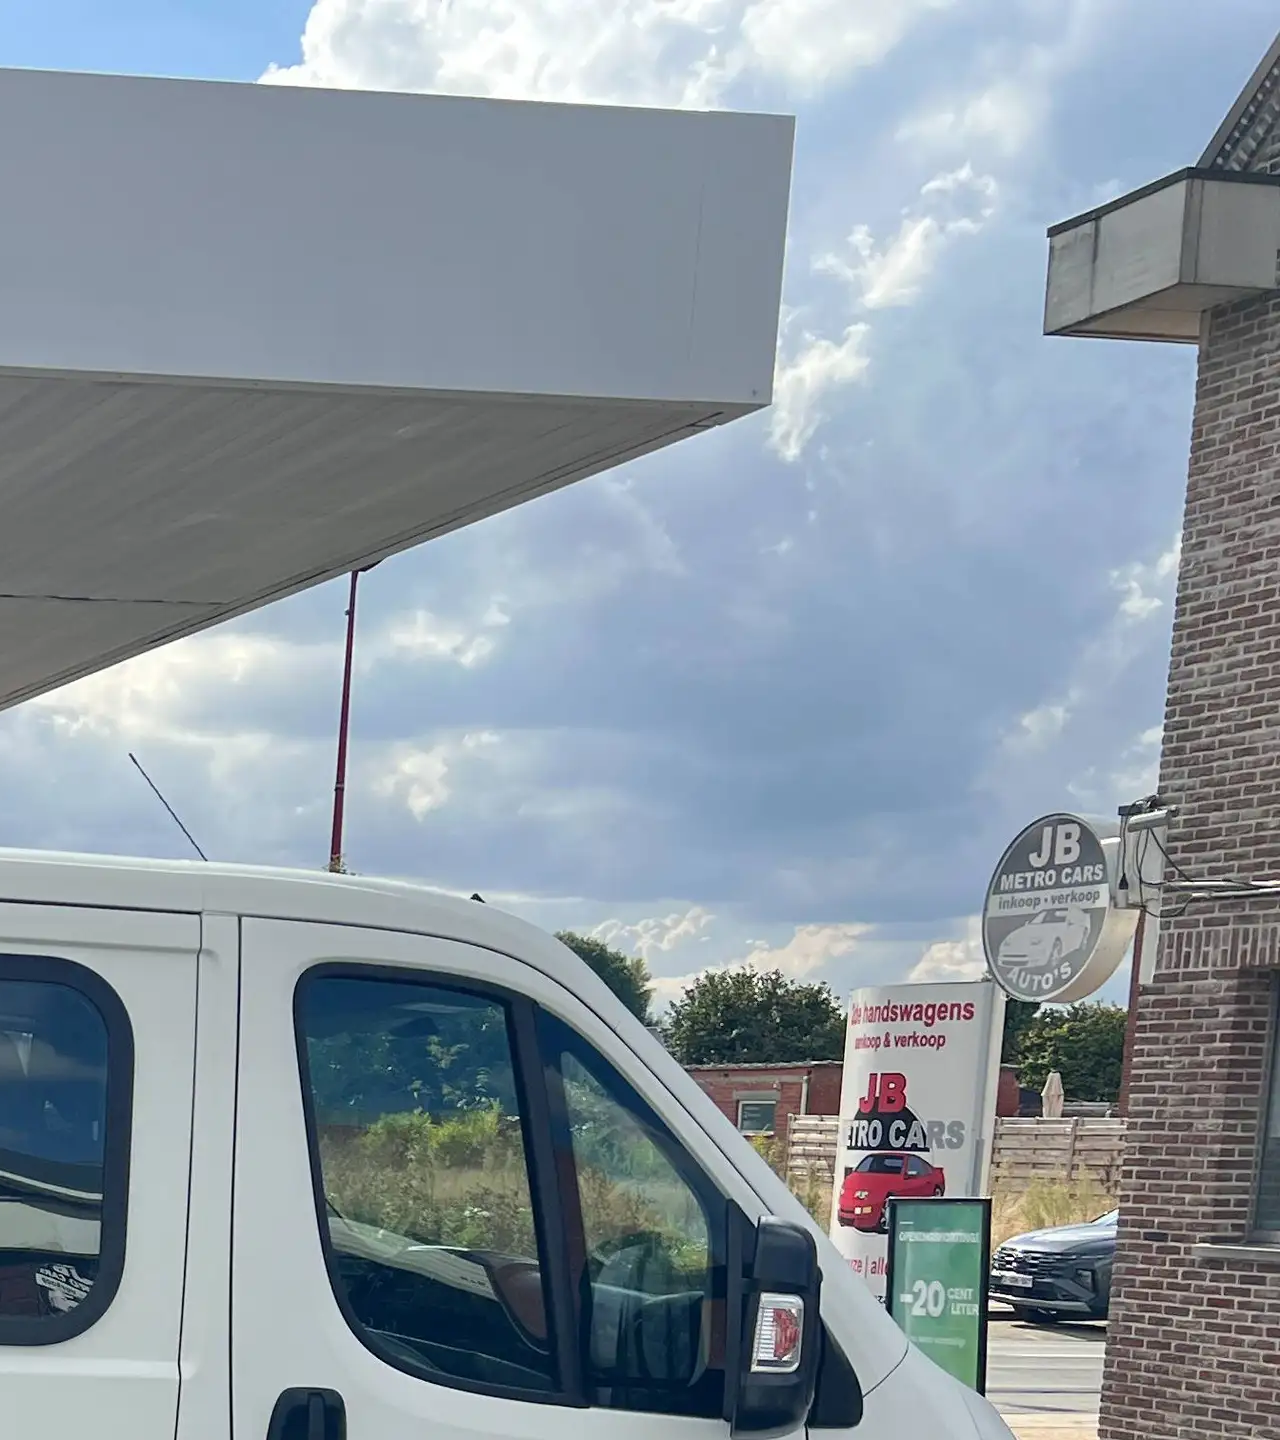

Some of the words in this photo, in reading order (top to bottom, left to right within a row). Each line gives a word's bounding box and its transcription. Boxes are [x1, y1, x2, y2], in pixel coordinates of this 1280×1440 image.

[1029, 823, 1081, 868] JB
[1000, 868, 1057, 891] METRO
[1061, 864, 1104, 885] CARS
[999, 894, 1041, 910] inkoop
[1050, 889, 1100, 905] verkoop
[1007, 961, 1072, 991] AUTO'S
[863, 999, 975, 1027] handswagens
[883, 1031, 891, 1048] &
[894, 1031, 946, 1051] verkoop
[859, 1072, 907, 1113] JB
[889, 1119, 966, 1150] CARS
[900, 1279, 945, 1317] -20
[947, 1287, 974, 1300] CENT
